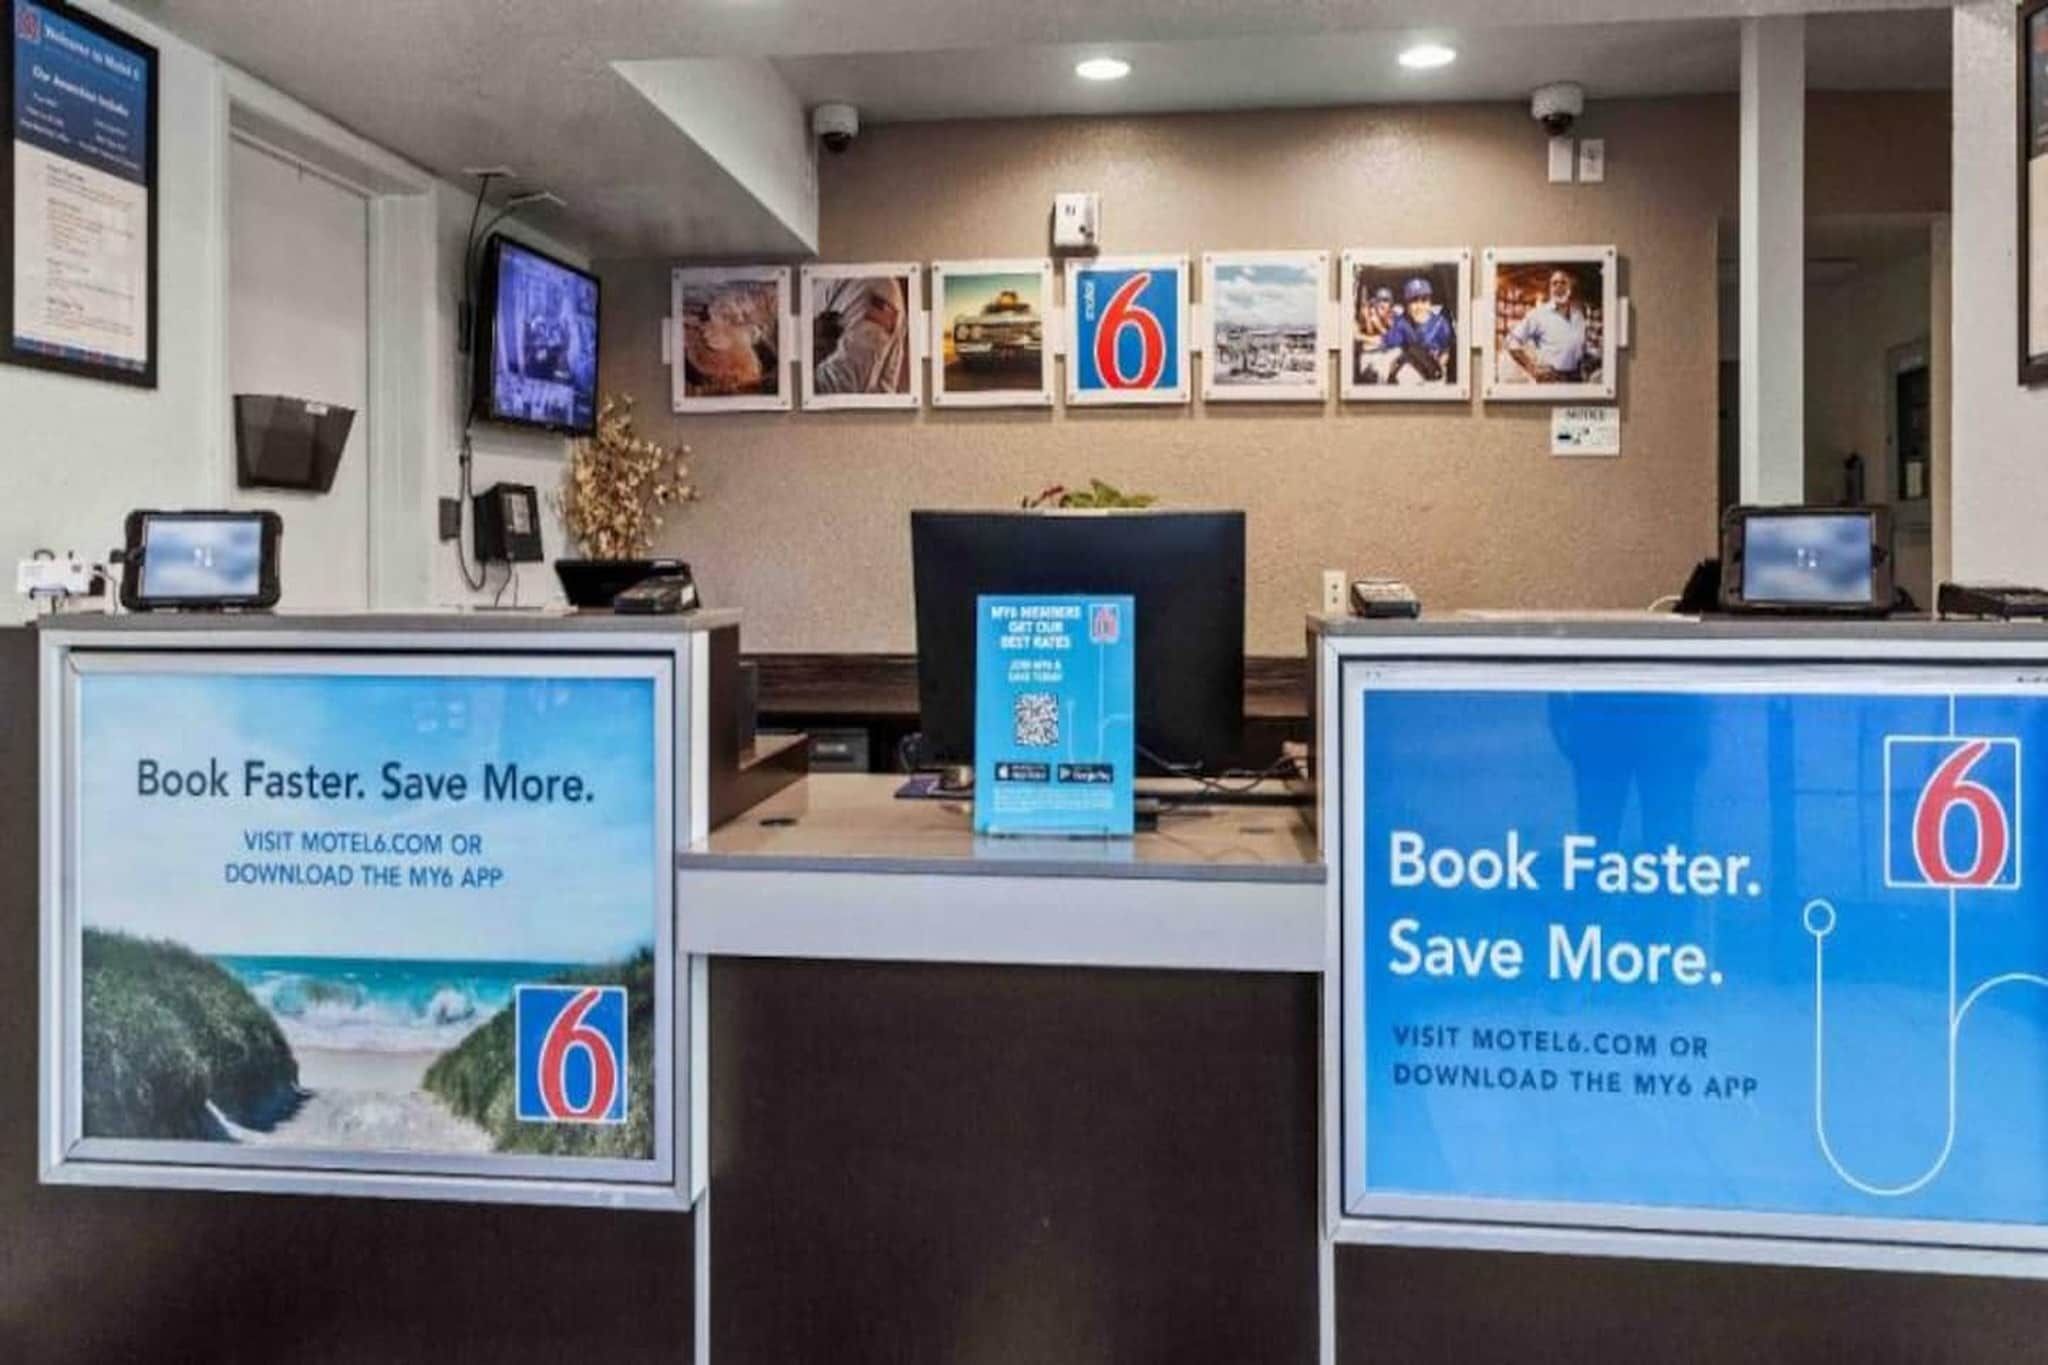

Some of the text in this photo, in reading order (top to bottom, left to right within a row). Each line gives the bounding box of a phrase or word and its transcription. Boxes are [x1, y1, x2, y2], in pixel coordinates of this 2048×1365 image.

[1093, 271, 1167, 391] 6
[138, 757, 594, 803] Book Faster. Save More.
[1912, 739, 2009, 888] 6
[244, 830, 482, 855] VISIT MOTEL6.COM OR
[1390, 830, 1762, 896] Book Faster.
[226, 863, 504, 889] DOWNLOAD THE MY6 APP
[1389, 918, 1723, 986] Save More.
[537, 986, 618, 1120] 6
[1393, 1026, 1708, 1058] VISIT MOTEL6.COM OR
[1393, 1064, 1759, 1099] DOWNLOAD THE MY6 APP
